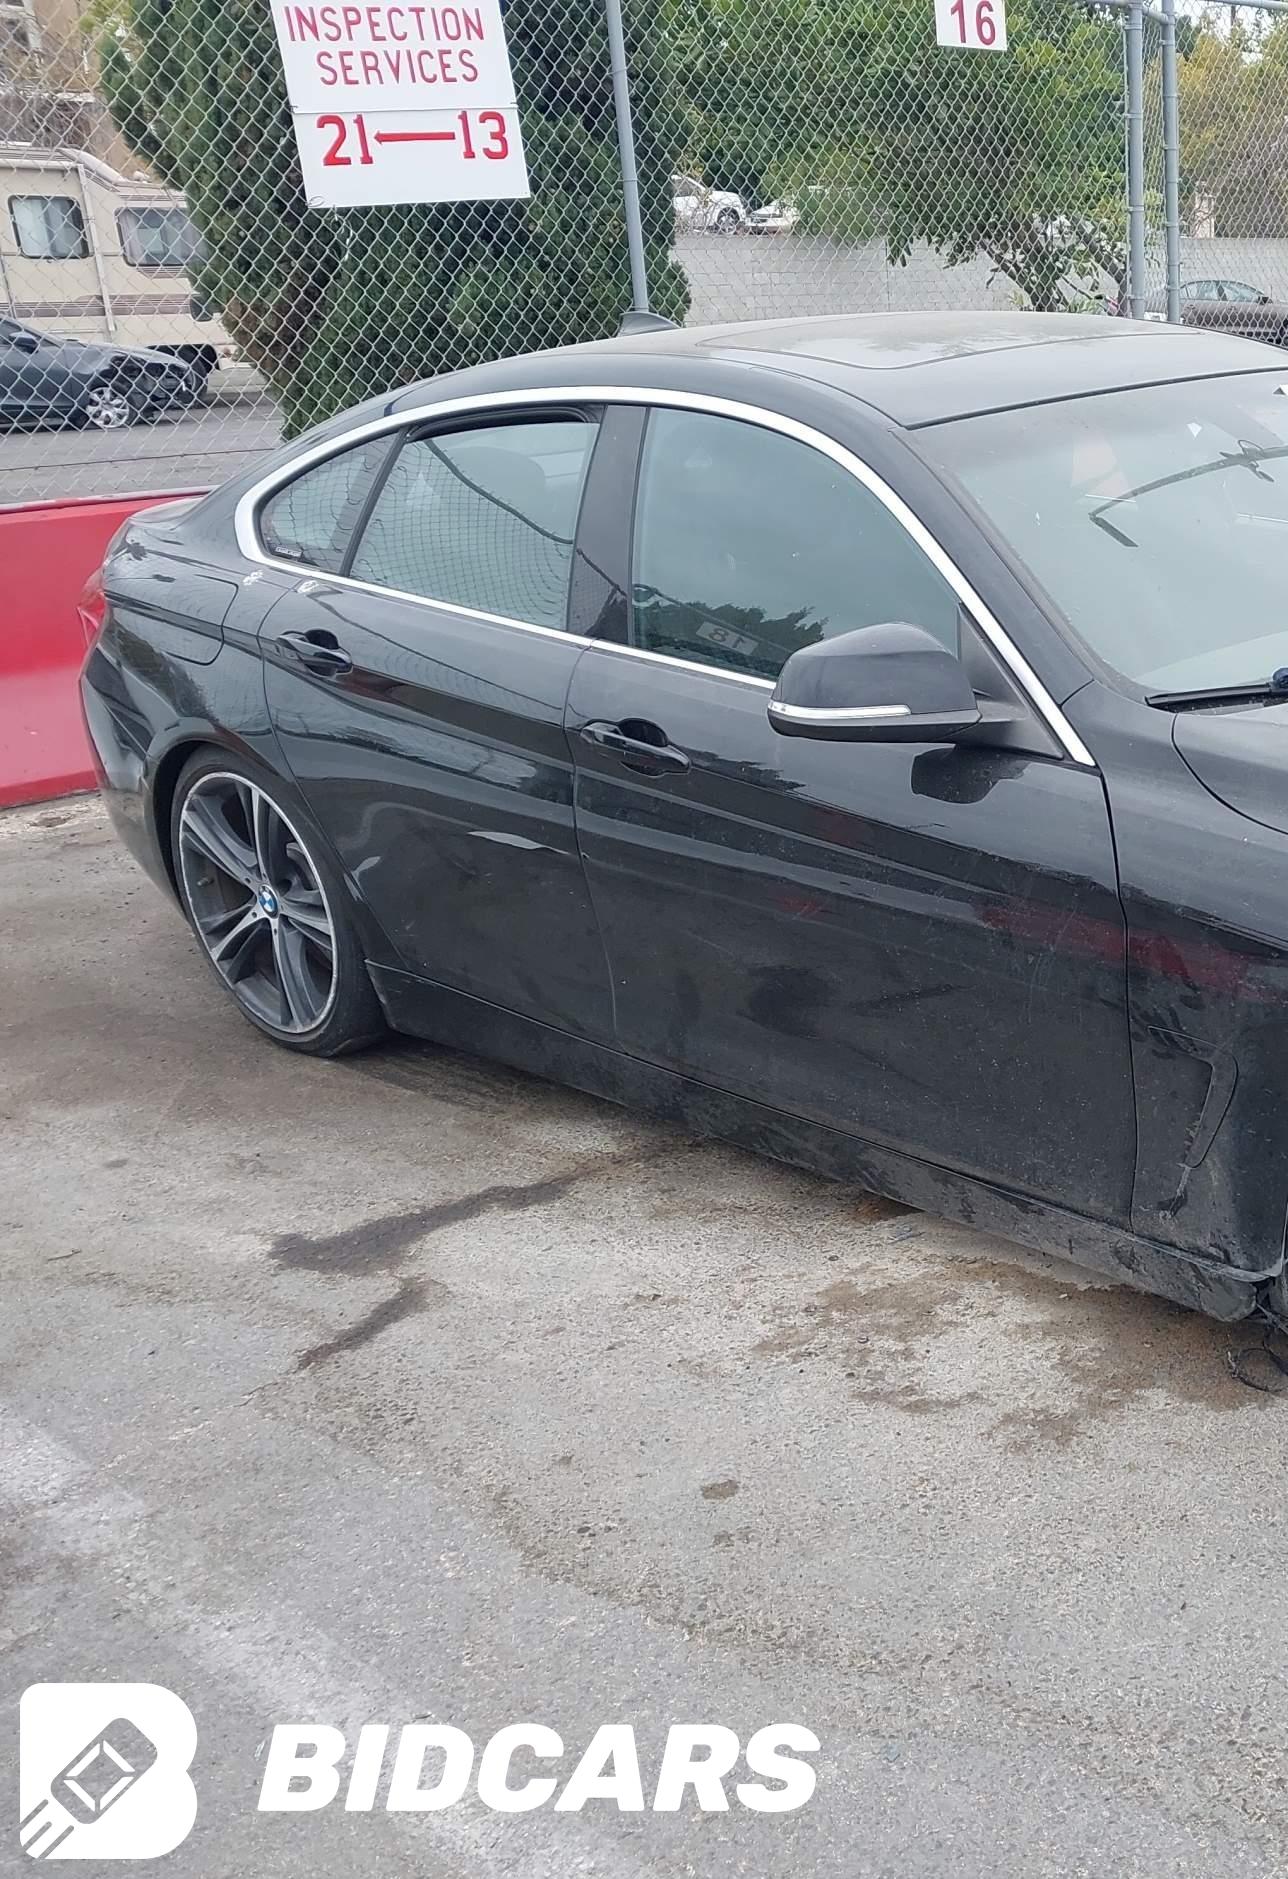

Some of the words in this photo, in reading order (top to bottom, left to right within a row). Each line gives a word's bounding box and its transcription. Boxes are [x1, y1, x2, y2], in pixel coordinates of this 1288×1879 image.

[284, 6, 485, 42] INSPECTION
[950, 0, 996, 46] 16
[316, 49, 479, 86] SERVICES
[316, 113, 374, 167] 21
[457, 110, 510, 161] 13
